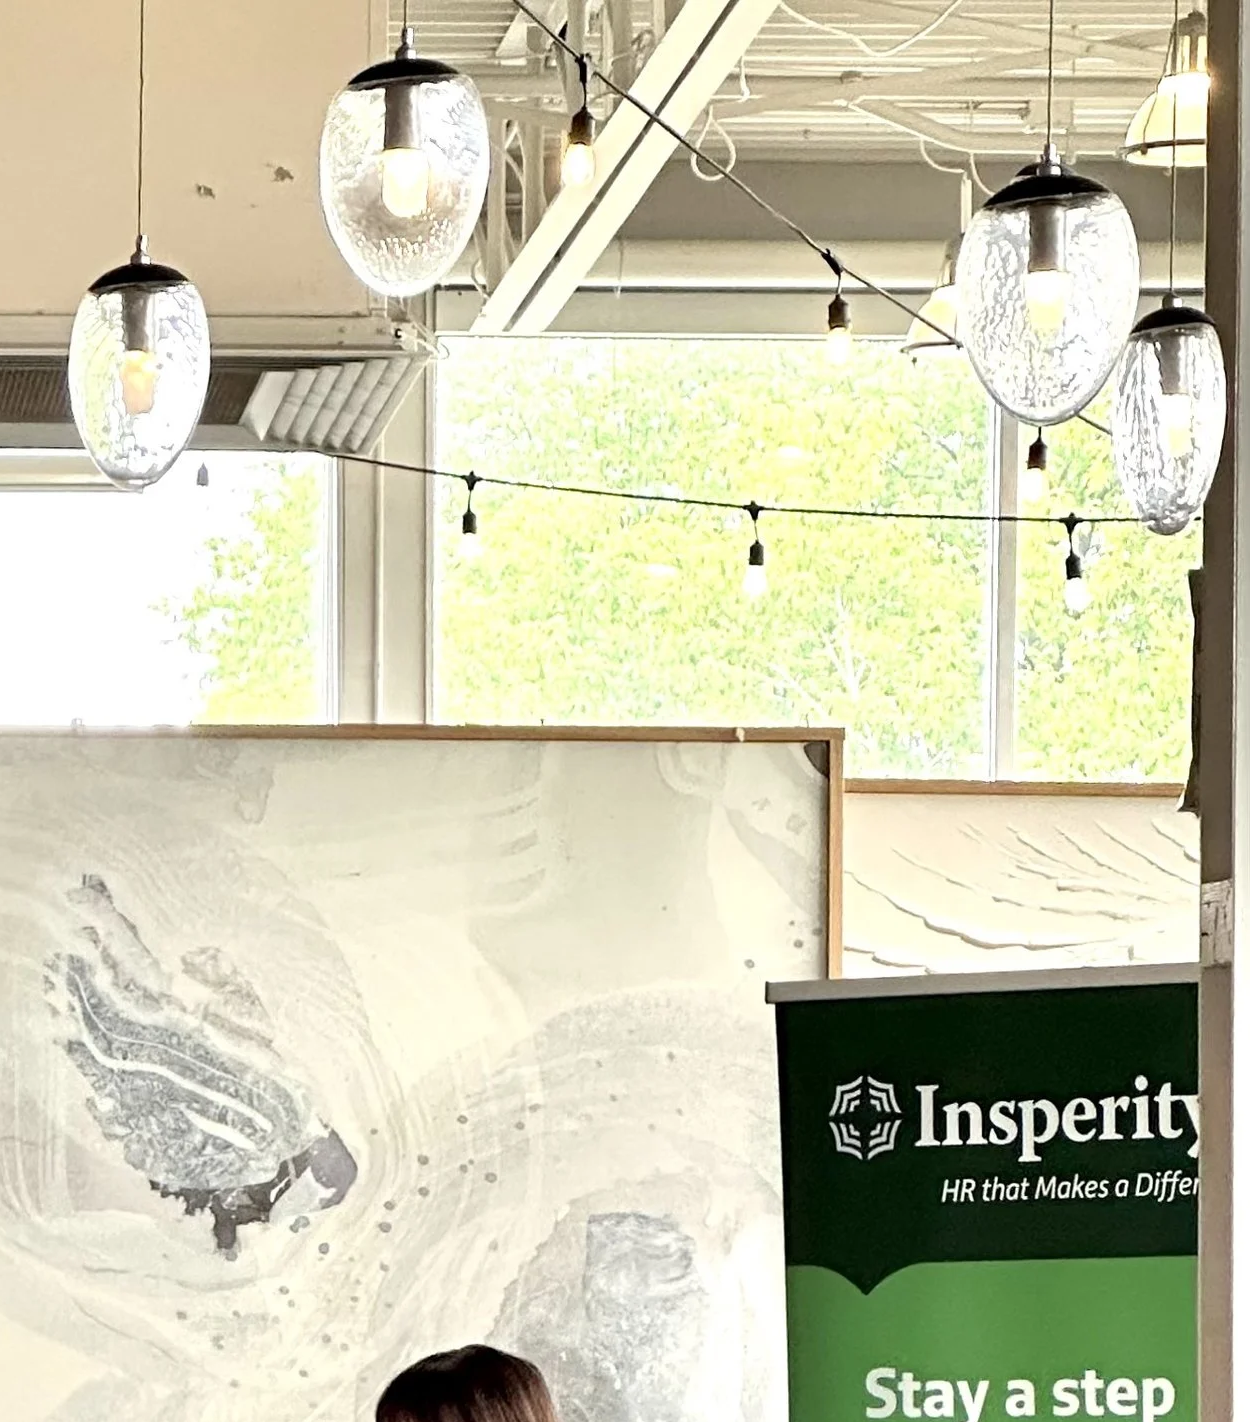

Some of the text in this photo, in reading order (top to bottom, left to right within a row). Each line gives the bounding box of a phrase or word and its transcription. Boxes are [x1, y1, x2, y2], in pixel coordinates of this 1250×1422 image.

[942, 1178, 976, 1203] HR
[982, 1177, 1029, 1202] that
[1035, 1174, 1109, 1200] Makes
[1115, 1178, 1130, 1199] a
[1005, 1378, 1035, 1417] a
